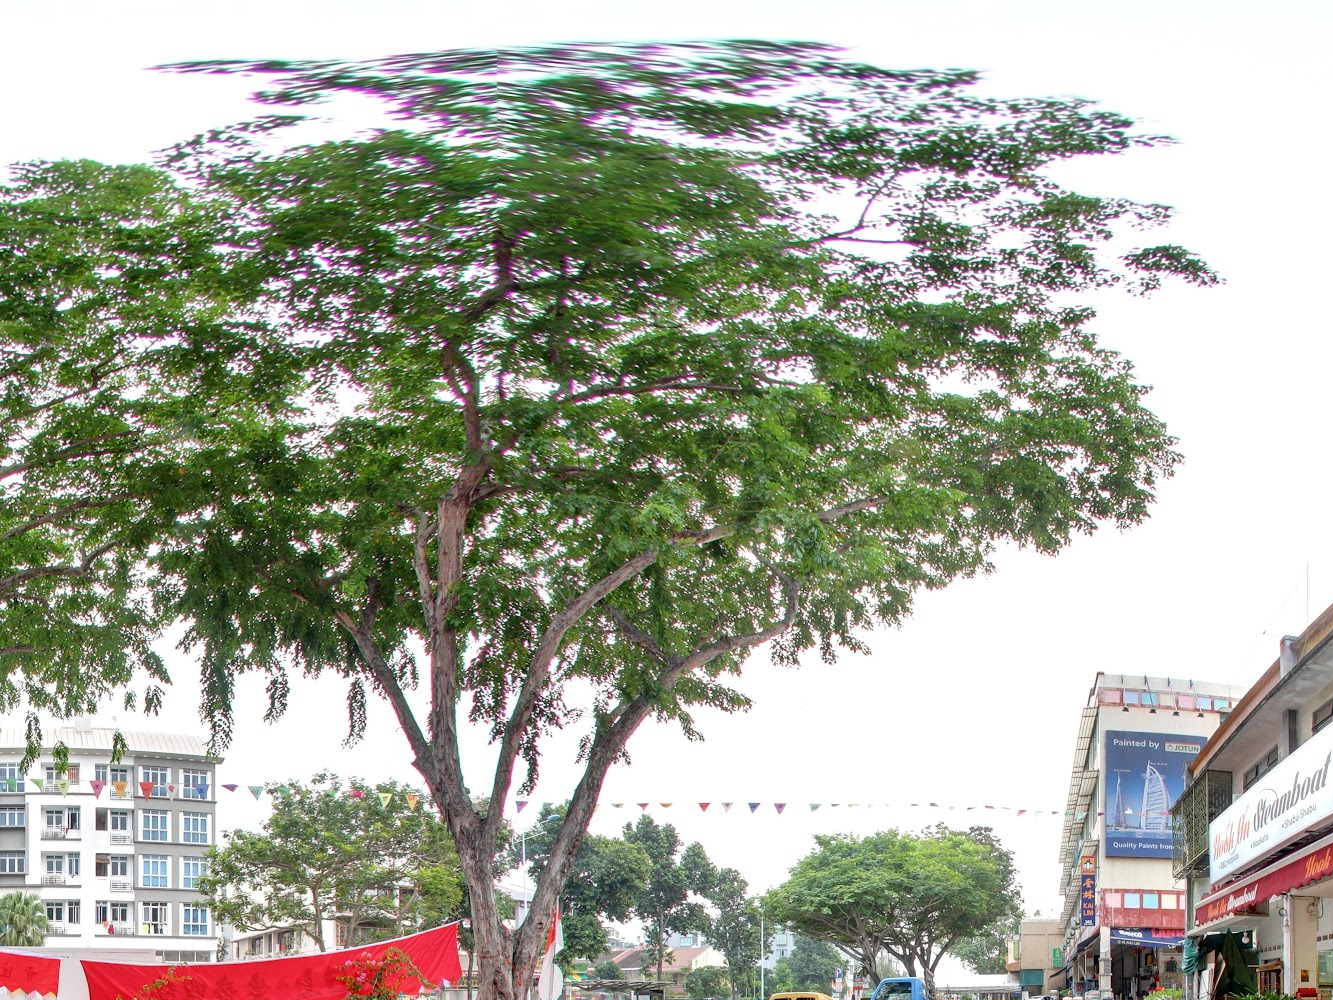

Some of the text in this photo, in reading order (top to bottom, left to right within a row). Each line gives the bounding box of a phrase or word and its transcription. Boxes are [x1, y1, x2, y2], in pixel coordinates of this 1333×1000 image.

[1113, 738, 1160, 750] Painted by
[1174, 744, 1199, 753] JOTUN
[1212, 751, 1333, 862] Hook On Steamboat
[1284, 803, 1317, 829] Shabu-Shabu
[1112, 841, 1137, 850] Quality
[1138, 842, 1158, 850] Paints
[1304, 851, 1330, 879] Hook
[1083, 909, 1094, 917] LIM
